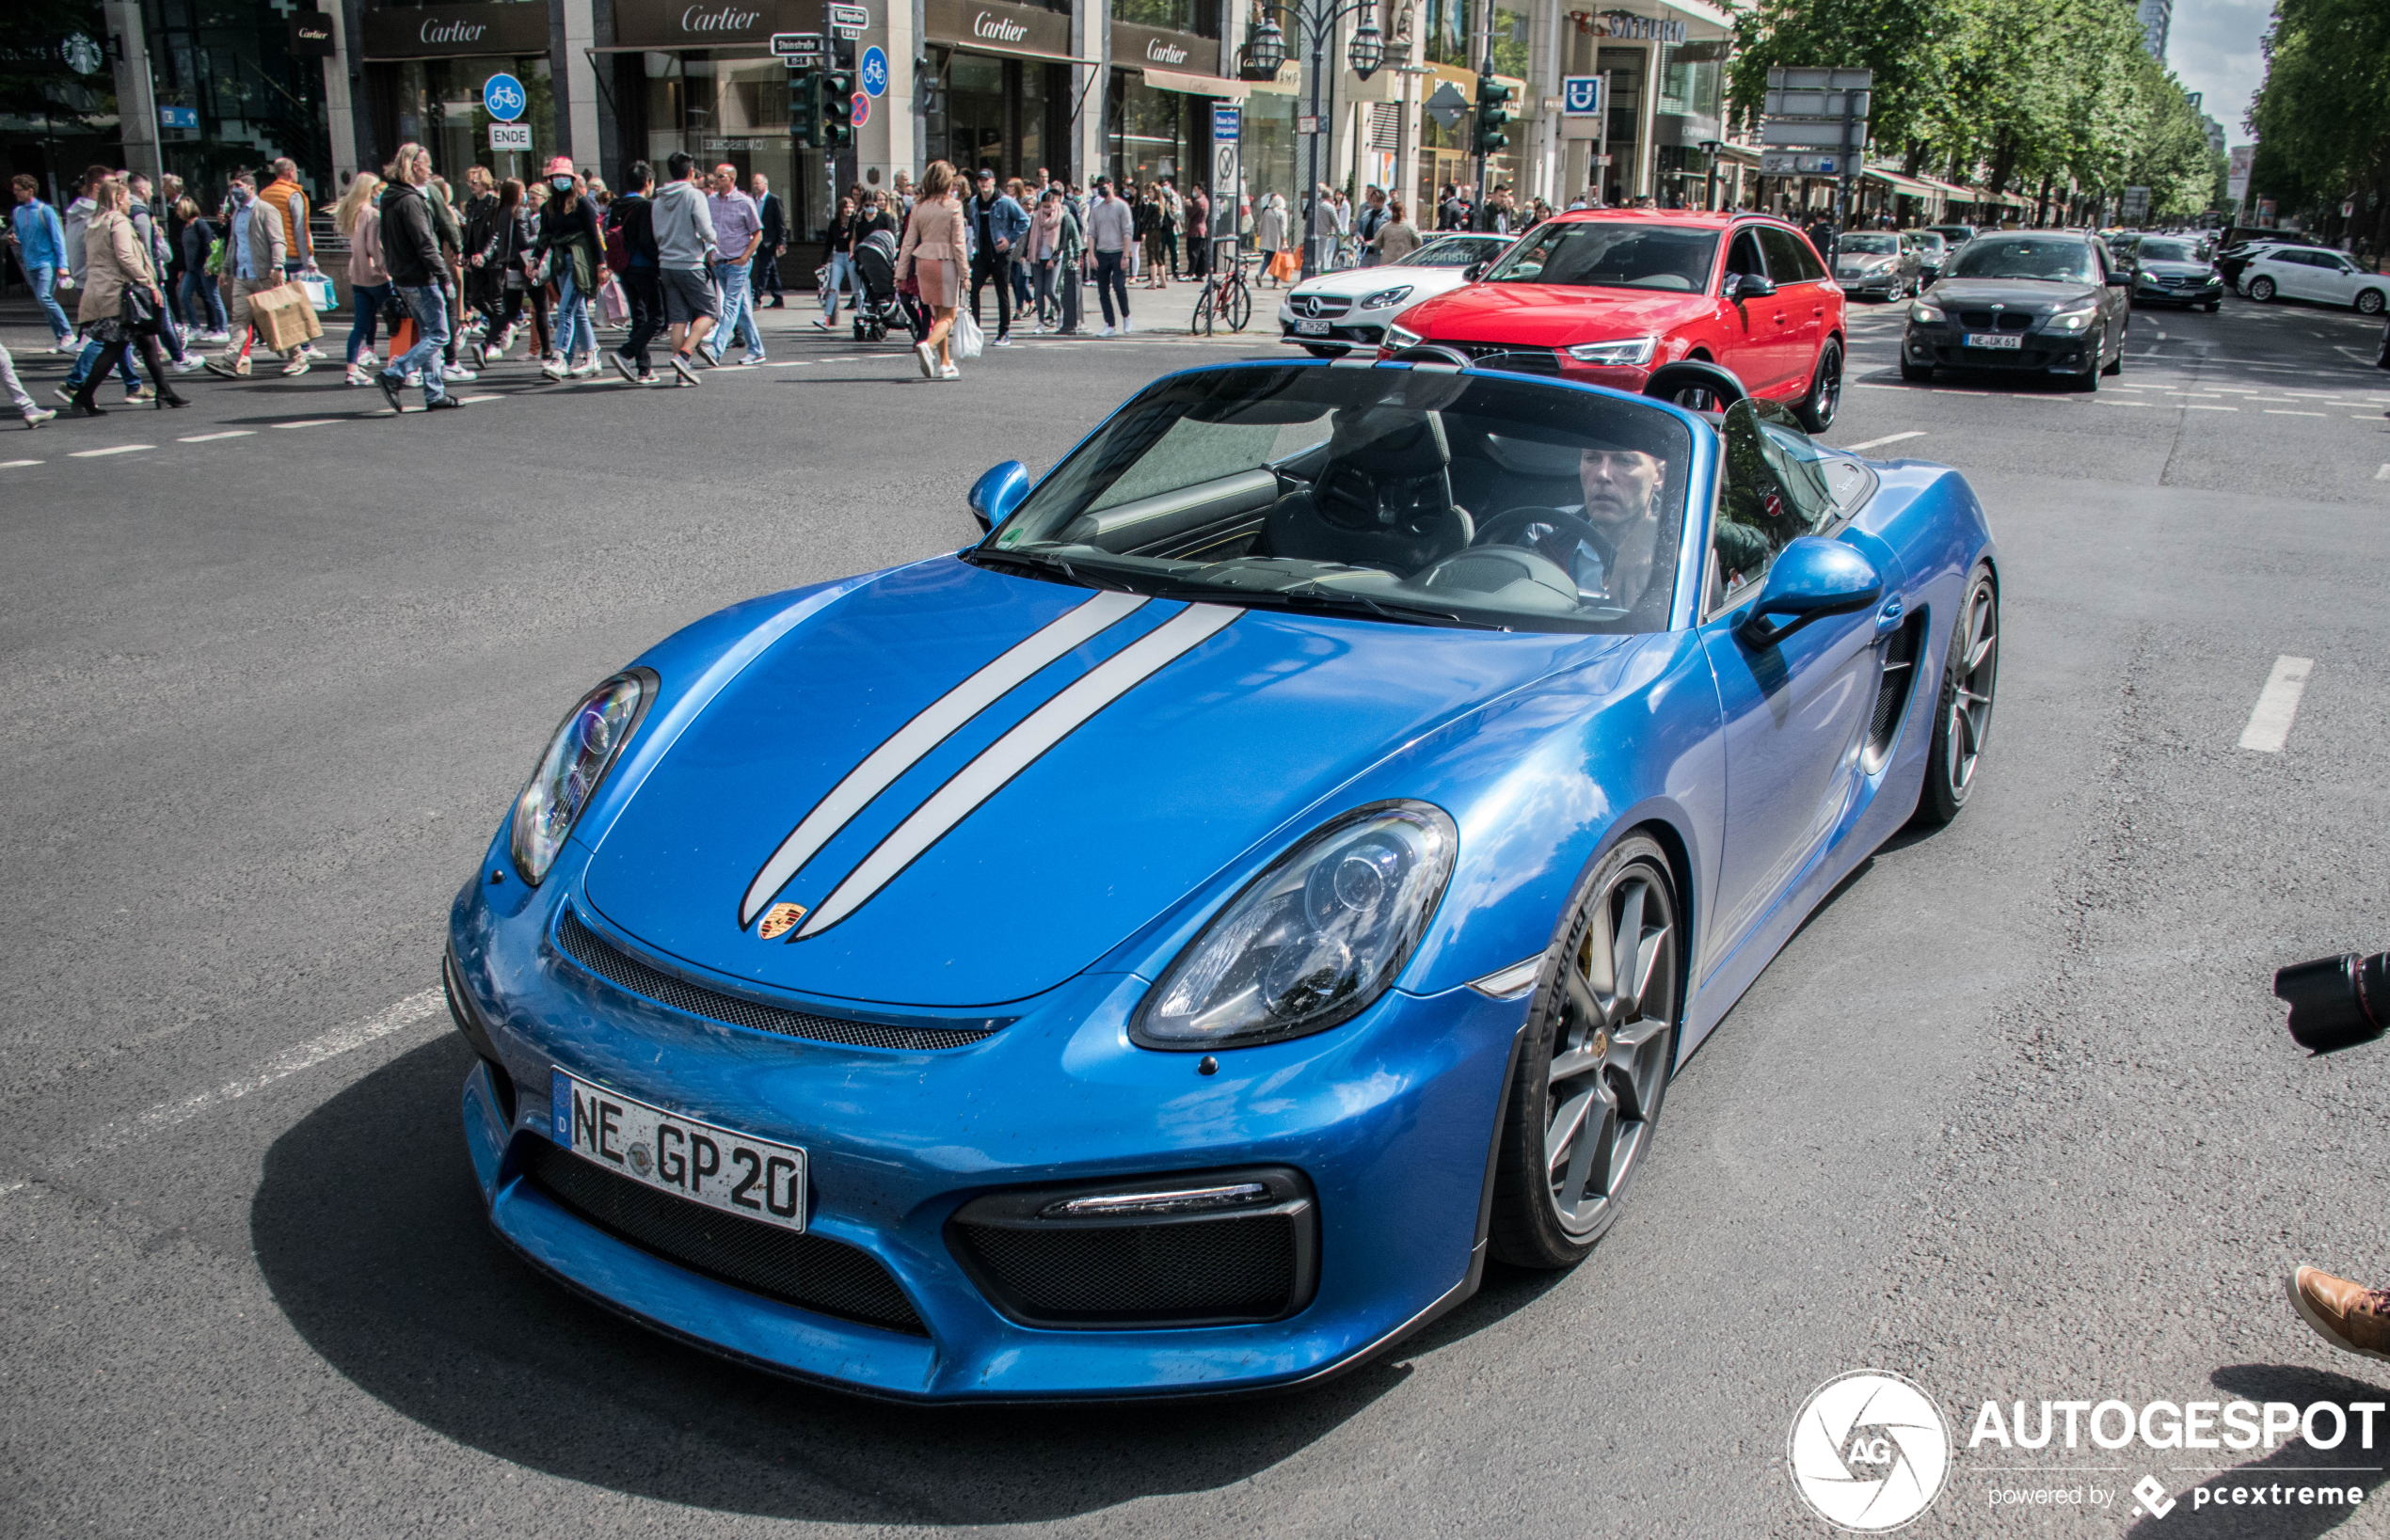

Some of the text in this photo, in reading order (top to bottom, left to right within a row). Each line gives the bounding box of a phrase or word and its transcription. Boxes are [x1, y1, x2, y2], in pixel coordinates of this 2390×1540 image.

[420, 18, 486, 43] Cartier
[682, 5, 760, 32] Cartier
[974, 11, 1028, 41] Cartier
[1609, 15, 1687, 43] SATURN
[298, 27, 328, 40] Cartier
[1146, 38, 1187, 65] Cartier
[494, 130, 526, 142] ENDE
[1315, 323, 1329, 332] 256
[1971, 336, 2016, 347] NE UK 61
[1723, 818, 1817, 938] PORSCHE
[1546, 906, 1585, 1016] MICHELIN
[558, 1116, 566, 1133] D
[574, 1088, 799, 1218] NE GP 20
